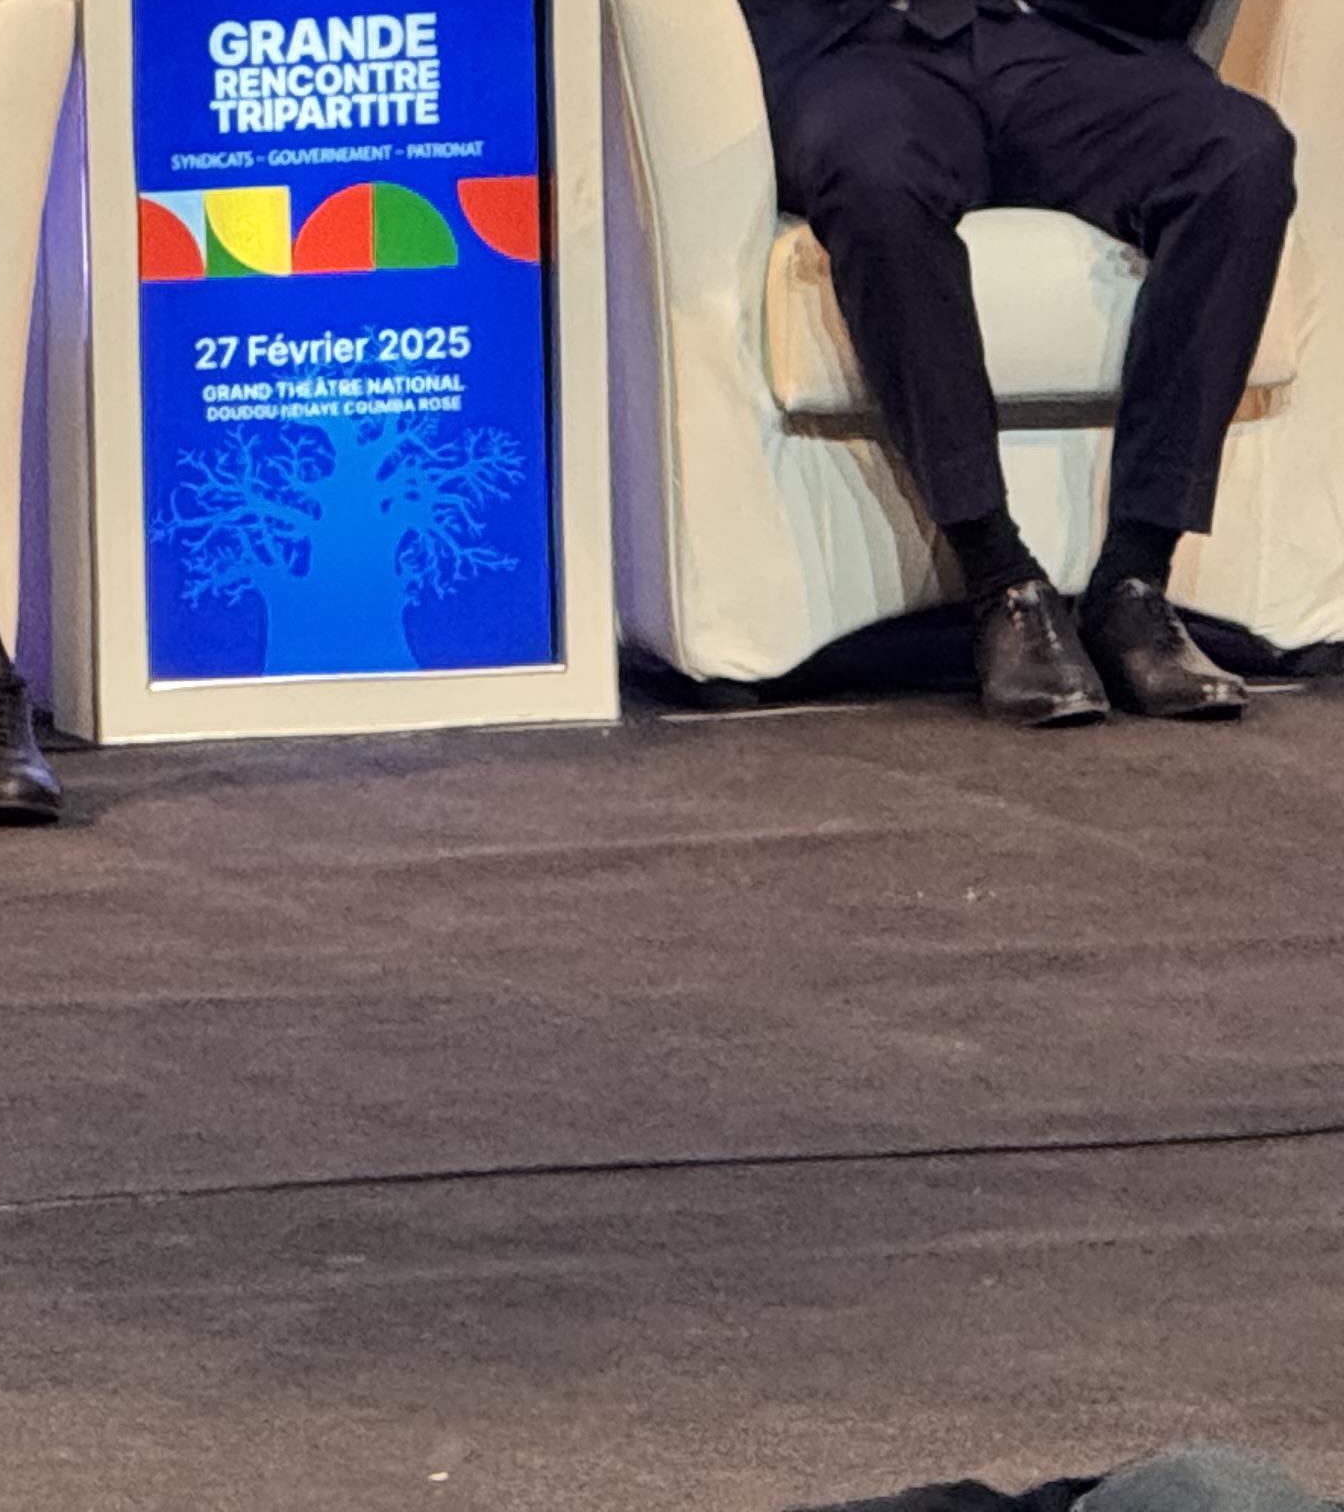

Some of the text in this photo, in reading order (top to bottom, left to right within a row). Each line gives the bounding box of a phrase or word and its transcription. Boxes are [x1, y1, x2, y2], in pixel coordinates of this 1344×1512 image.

[209, 13, 440, 68] GRANDE
[215, 58, 440, 101] RENCONTRE
[209, 90, 439, 133] TRIPARTITE
[171, 150, 255, 170] SYNDICATS
[267, 144, 392, 166] GOUVERNEMENT
[406, 140, 483, 159] PATRONAT
[195, 325, 471, 370] 27 Février 2025
[202, 382, 273, 403] GRAND
[366, 374, 465, 395] NATIONAL
